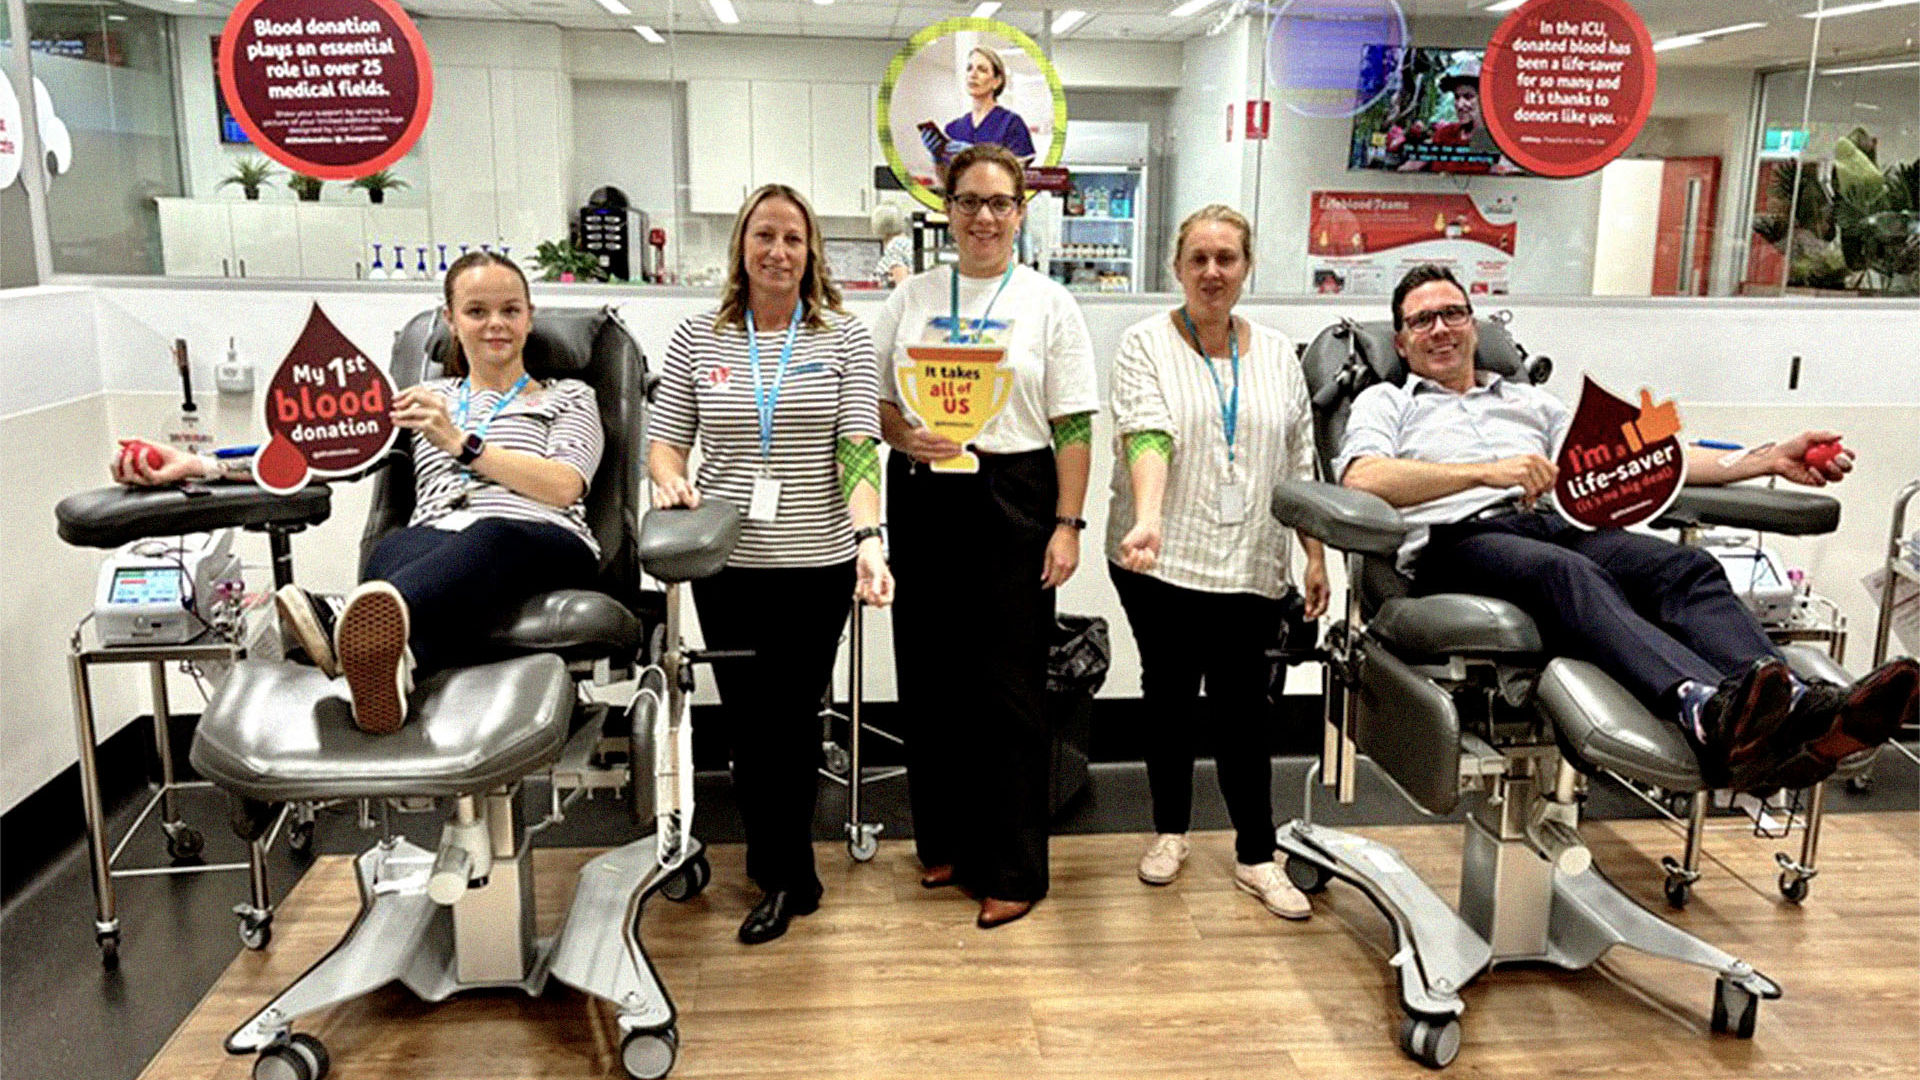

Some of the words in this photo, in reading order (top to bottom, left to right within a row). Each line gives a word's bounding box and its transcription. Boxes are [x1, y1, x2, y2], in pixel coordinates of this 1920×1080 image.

[254, 17, 303, 37] Blood
[306, 16, 381, 34] donation
[1540, 20, 1553, 35] In
[1556, 21, 1579, 35] the
[1581, 21, 1607, 38] ICU,
[247, 40, 293, 61] plays
[296, 42, 316, 56] an
[319, 38, 395, 55] essential
[1512, 38, 1566, 53] donated
[1569, 39, 1606, 54] blood
[1608, 40, 1631, 55] has
[266, 61, 299, 78] role
[302, 60, 320, 77] in
[323, 62, 358, 77] over
[362, 59, 383, 76] 25
[1516, 55, 1548, 70] been
[1550, 58, 1559, 70] a
[1562, 55, 1624, 72] life-saver
[268, 80, 336, 99] medical
[338, 79, 390, 97] fields.
[1517, 73, 1537, 87] for
[1539, 75, 1554, 88] so
[1557, 76, 1594, 91] many
[1596, 75, 1621, 90] and
[1524, 90, 1545, 105] it's
[1547, 90, 1592, 106] thanks
[1594, 92, 1609, 107] to
[1514, 108, 1558, 123] donors
[1561, 109, 1587, 123] like
[1589, 114, 1616, 127] you.
[292, 363, 326, 386] My
[327, 354, 367, 388] 1st
[925, 365, 936, 377] It
[940, 364, 980, 380] takes
[930, 380, 954, 397] all
[957, 381, 972, 394] of
[274, 378, 384, 422] blood
[943, 398, 970, 414] US
[290, 417, 379, 442] donation
[1568, 443, 1612, 474] I'm
[1566, 445, 1675, 499] life-saver
